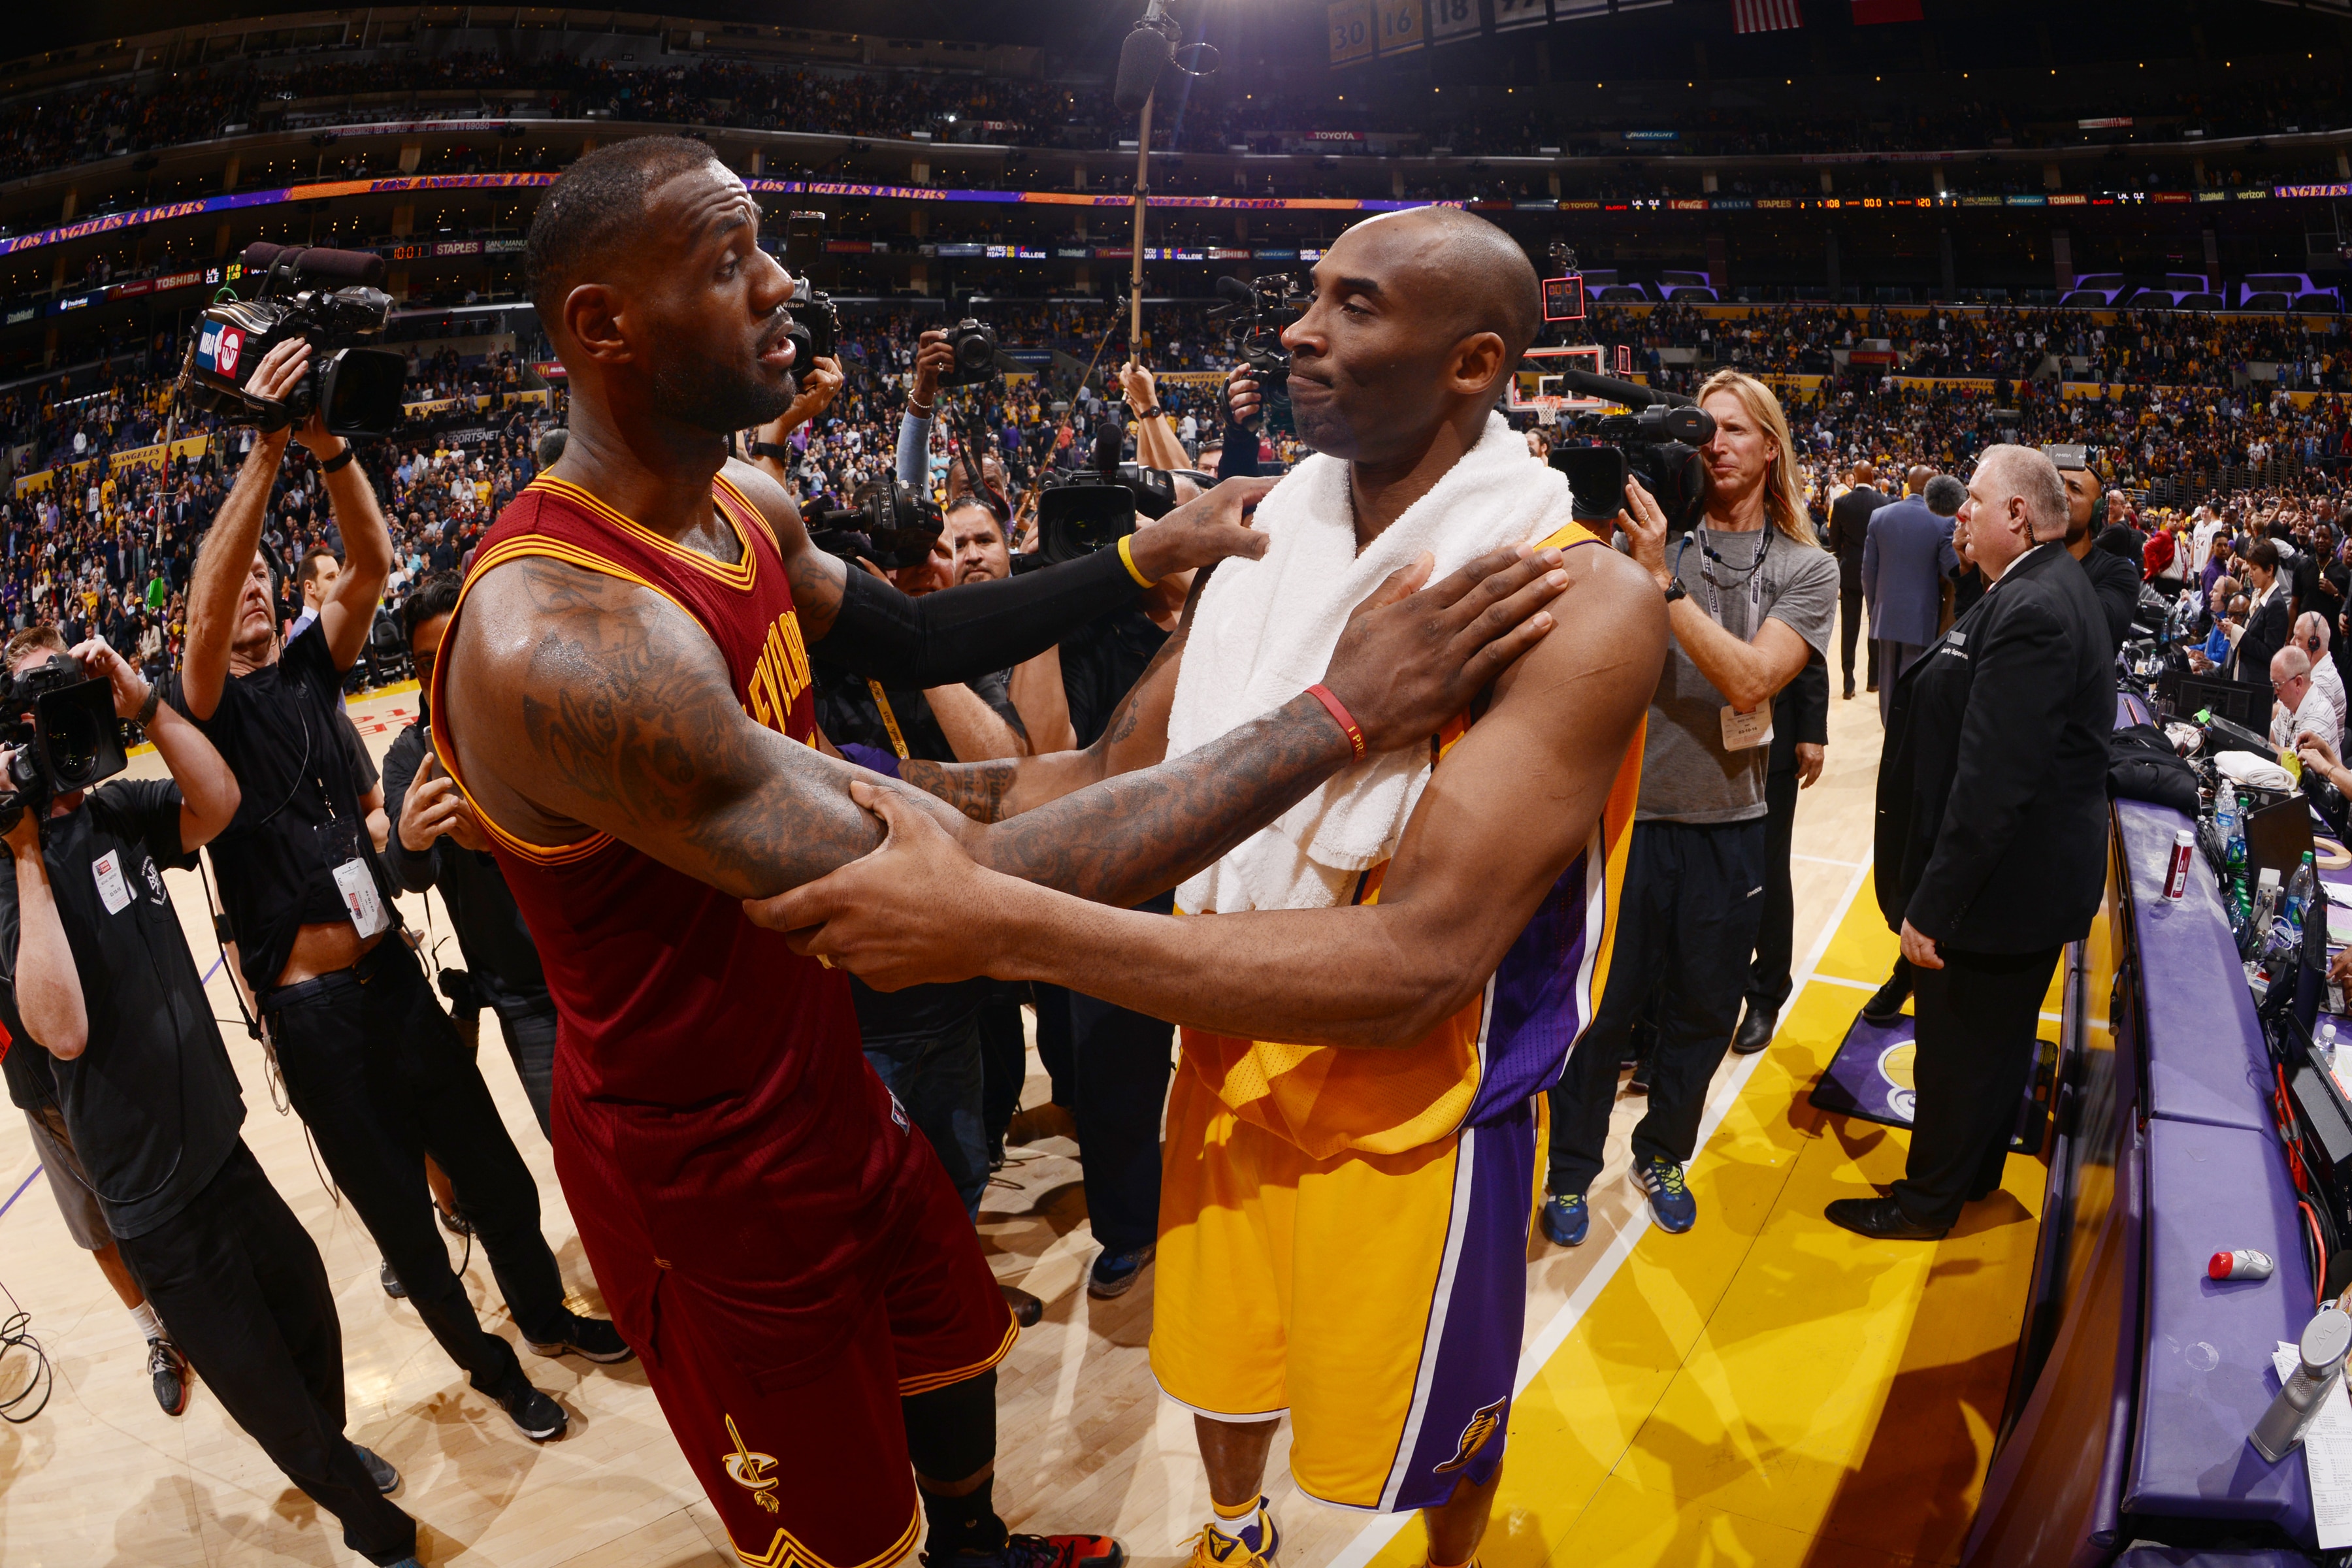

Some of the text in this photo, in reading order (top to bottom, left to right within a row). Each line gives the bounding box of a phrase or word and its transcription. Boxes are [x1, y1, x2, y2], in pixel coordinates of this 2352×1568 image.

[1441, 0, 1469, 24] 18
[1386, 7, 1412, 37] 16
[1335, 20, 1366, 50] 30
[374, 125, 384, 134] TEXT
[1315, 131, 1354, 140] TOYOTA
[370, 178, 412, 191] LOS
[418, 174, 507, 188] ANGELES
[749, 180, 947, 200] LOS ANGELES LAKERS
[2237, 189, 2266, 199] verizon
[2276, 185, 2348, 197] ANGELES
[1093, 196, 1287, 208] LOS NGELES LAKERS
[2199, 192, 2225, 201] StubHub!
[1827, 199, 1840, 208] 108
[1918, 199, 1931, 207] 120
[8, 199, 207, 252] LOS ANGELES LAKERS
[393, 246, 422, 259] 10:01
[436, 242, 478, 255] STAPLES
[1058, 248, 1086, 257] StubHub!
[1209, 250, 1250, 259] TOSHIBA
[206, 267, 220, 277] LAL
[242, 267, 248, 276] 4
[156, 272, 201, 289] TOSHIBA
[206, 275, 220, 284] CLE
[67, 297, 88, 308] Prudential
[7, 308, 35, 325] StubHub!
[199, 331, 216, 356] NBA
[446, 431, 500, 445] SPORTSNET
[117, 448, 160, 463] ANGELES
[18, 481, 29, 489] 110
[2196, 540, 2205, 549] 24
